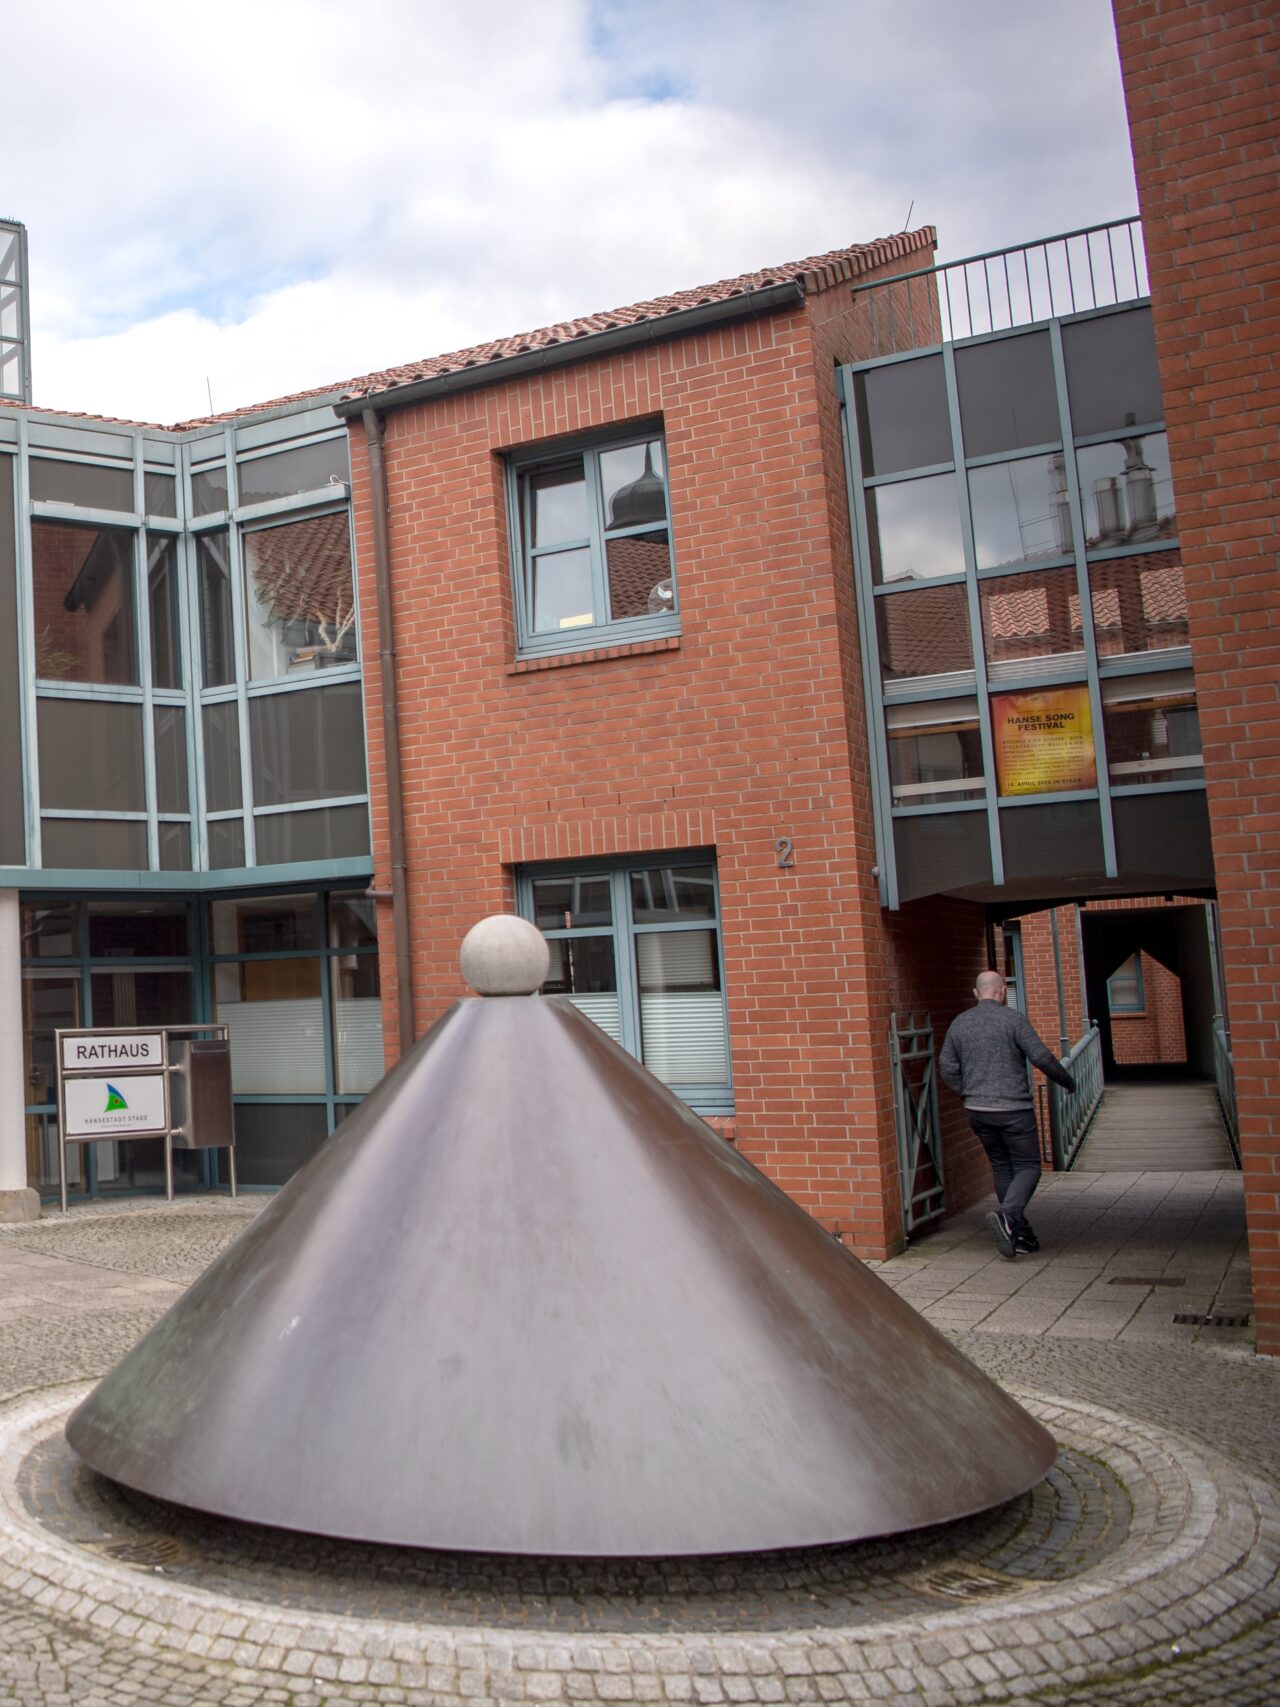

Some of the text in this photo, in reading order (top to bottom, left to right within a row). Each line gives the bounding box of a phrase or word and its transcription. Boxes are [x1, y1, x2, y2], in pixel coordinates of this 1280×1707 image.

[1007, 713, 1075, 725] HANSE SONG
[1017, 722, 1065, 731] FESTIVAL
[775, 836, 795, 868] 2
[76, 1043, 150, 1060] RATHAUS
[84, 1116, 126, 1124] HANSESTADT
